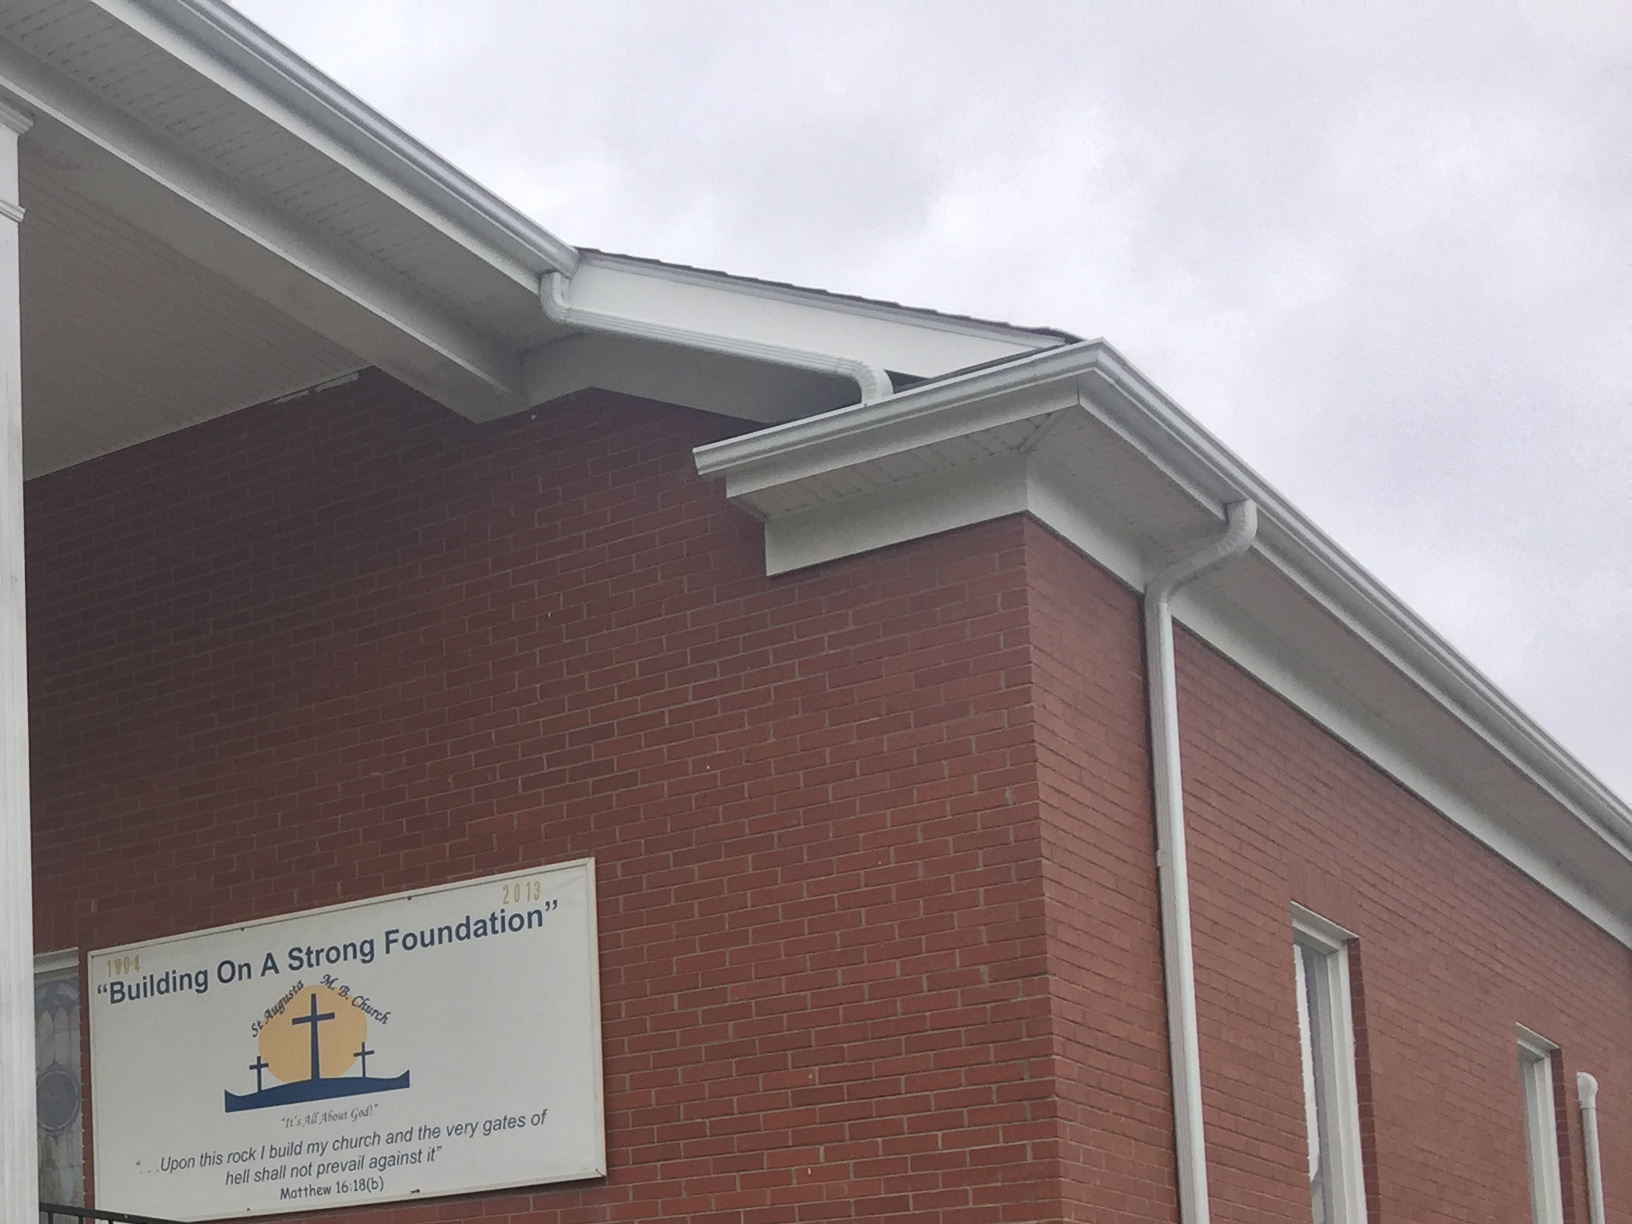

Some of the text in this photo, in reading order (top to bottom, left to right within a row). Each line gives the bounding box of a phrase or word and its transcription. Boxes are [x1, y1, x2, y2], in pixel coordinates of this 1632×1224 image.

[502, 881, 541, 905] 2013
[106, 954, 141, 978] 1904
[217, 959, 252, 984] On
[260, 952, 280, 977] A
[287, 938, 375, 971] Strong
[251, 1021, 263, 1038] St
[264, 980, 304, 1024] Augusta
[351, 995, 391, 1025] Church
[302, 1111, 319, 1128] All
[318, 1109, 348, 1126] About
[199, 1151, 223, 1168] this
[226, 1147, 257, 1164] rock
[260, 1145, 266, 1160] I
[269, 1141, 303, 1159] build
[306, 1139, 329, 1158] my
[332, 1131, 381, 1151] church
[385, 1127, 414, 1145] and
[418, 1124, 441, 1141] the
[446, 1121, 479, 1138] very
[482, 1114, 526, 1136] gates
[530, 1108, 548, 1126] of
[225, 1168, 250, 1186] hell
[253, 1164, 286, 1183] shall
[290, 1161, 313, 1178] not
[316, 1155, 365, 1178] prevail
[369, 1150, 423, 1172] against
[279, 1182, 332, 1201] Matthew
